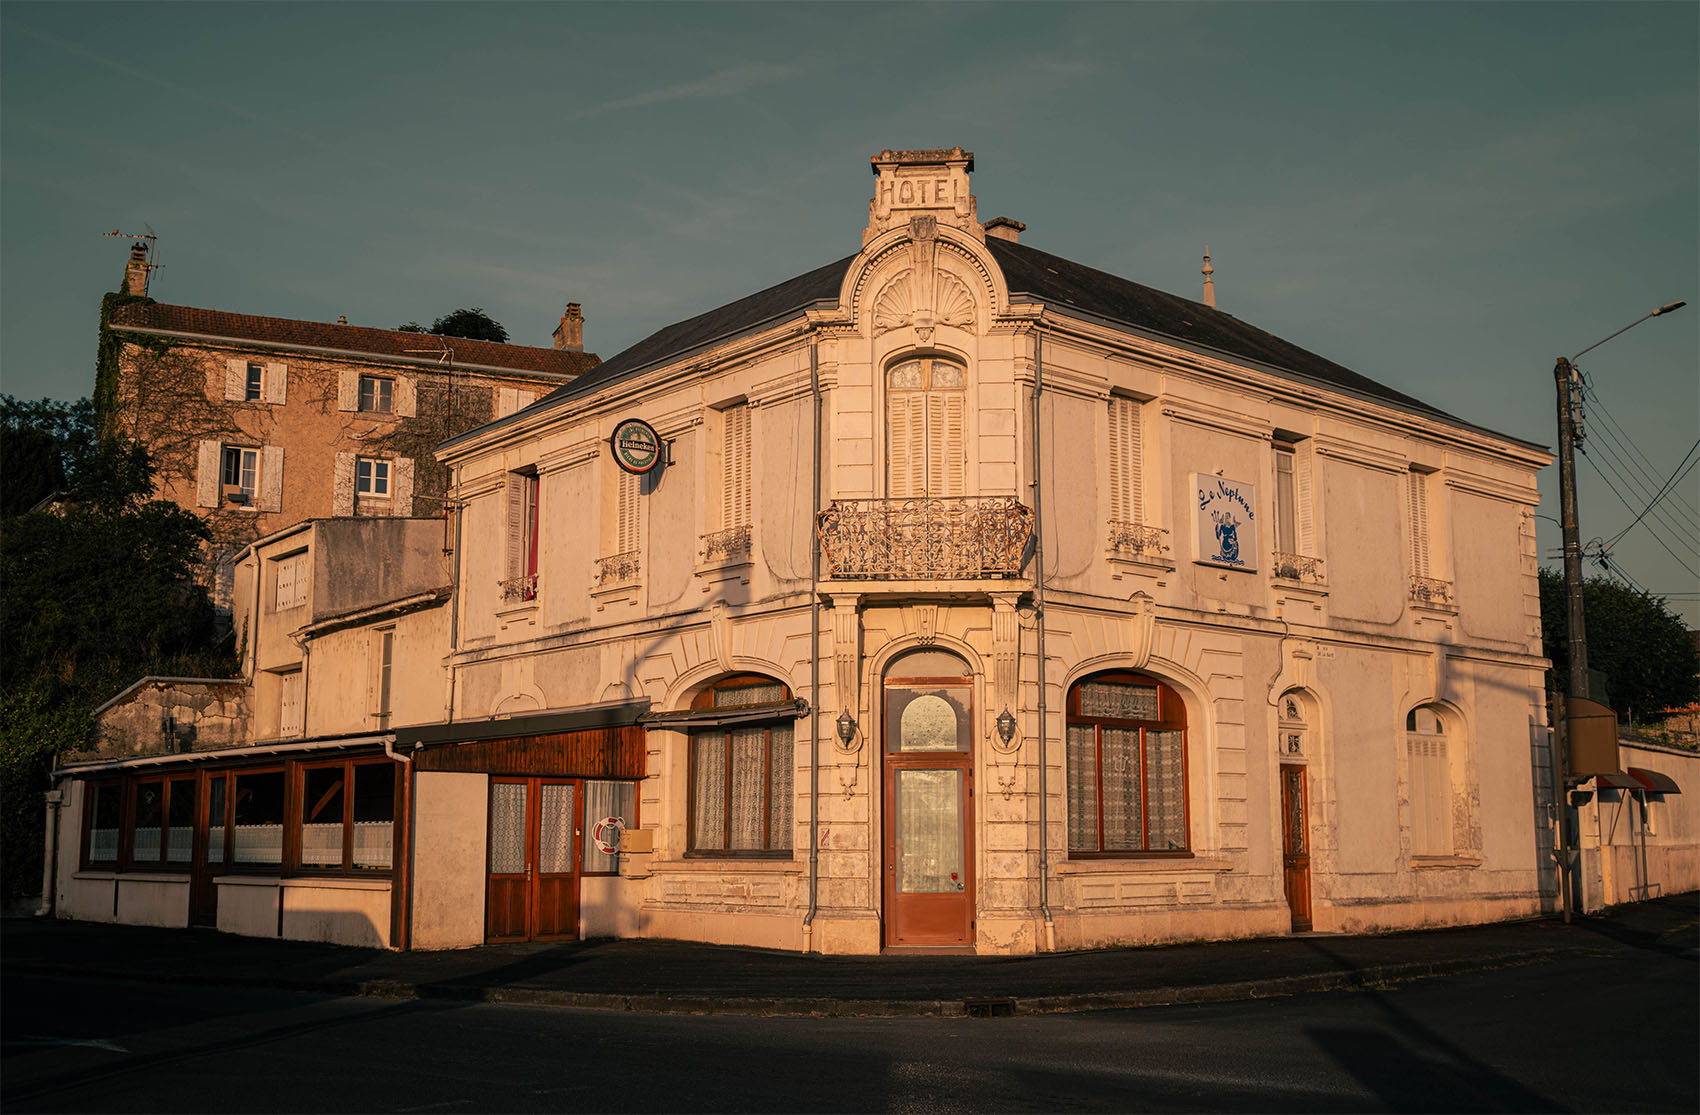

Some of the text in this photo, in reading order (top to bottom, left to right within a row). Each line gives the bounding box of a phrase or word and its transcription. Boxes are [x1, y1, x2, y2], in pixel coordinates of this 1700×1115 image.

[880, 179, 966, 205] HOTEL
[622, 440, 655, 452] Heineken
[1199, 480, 1254, 520] Le Neptune
